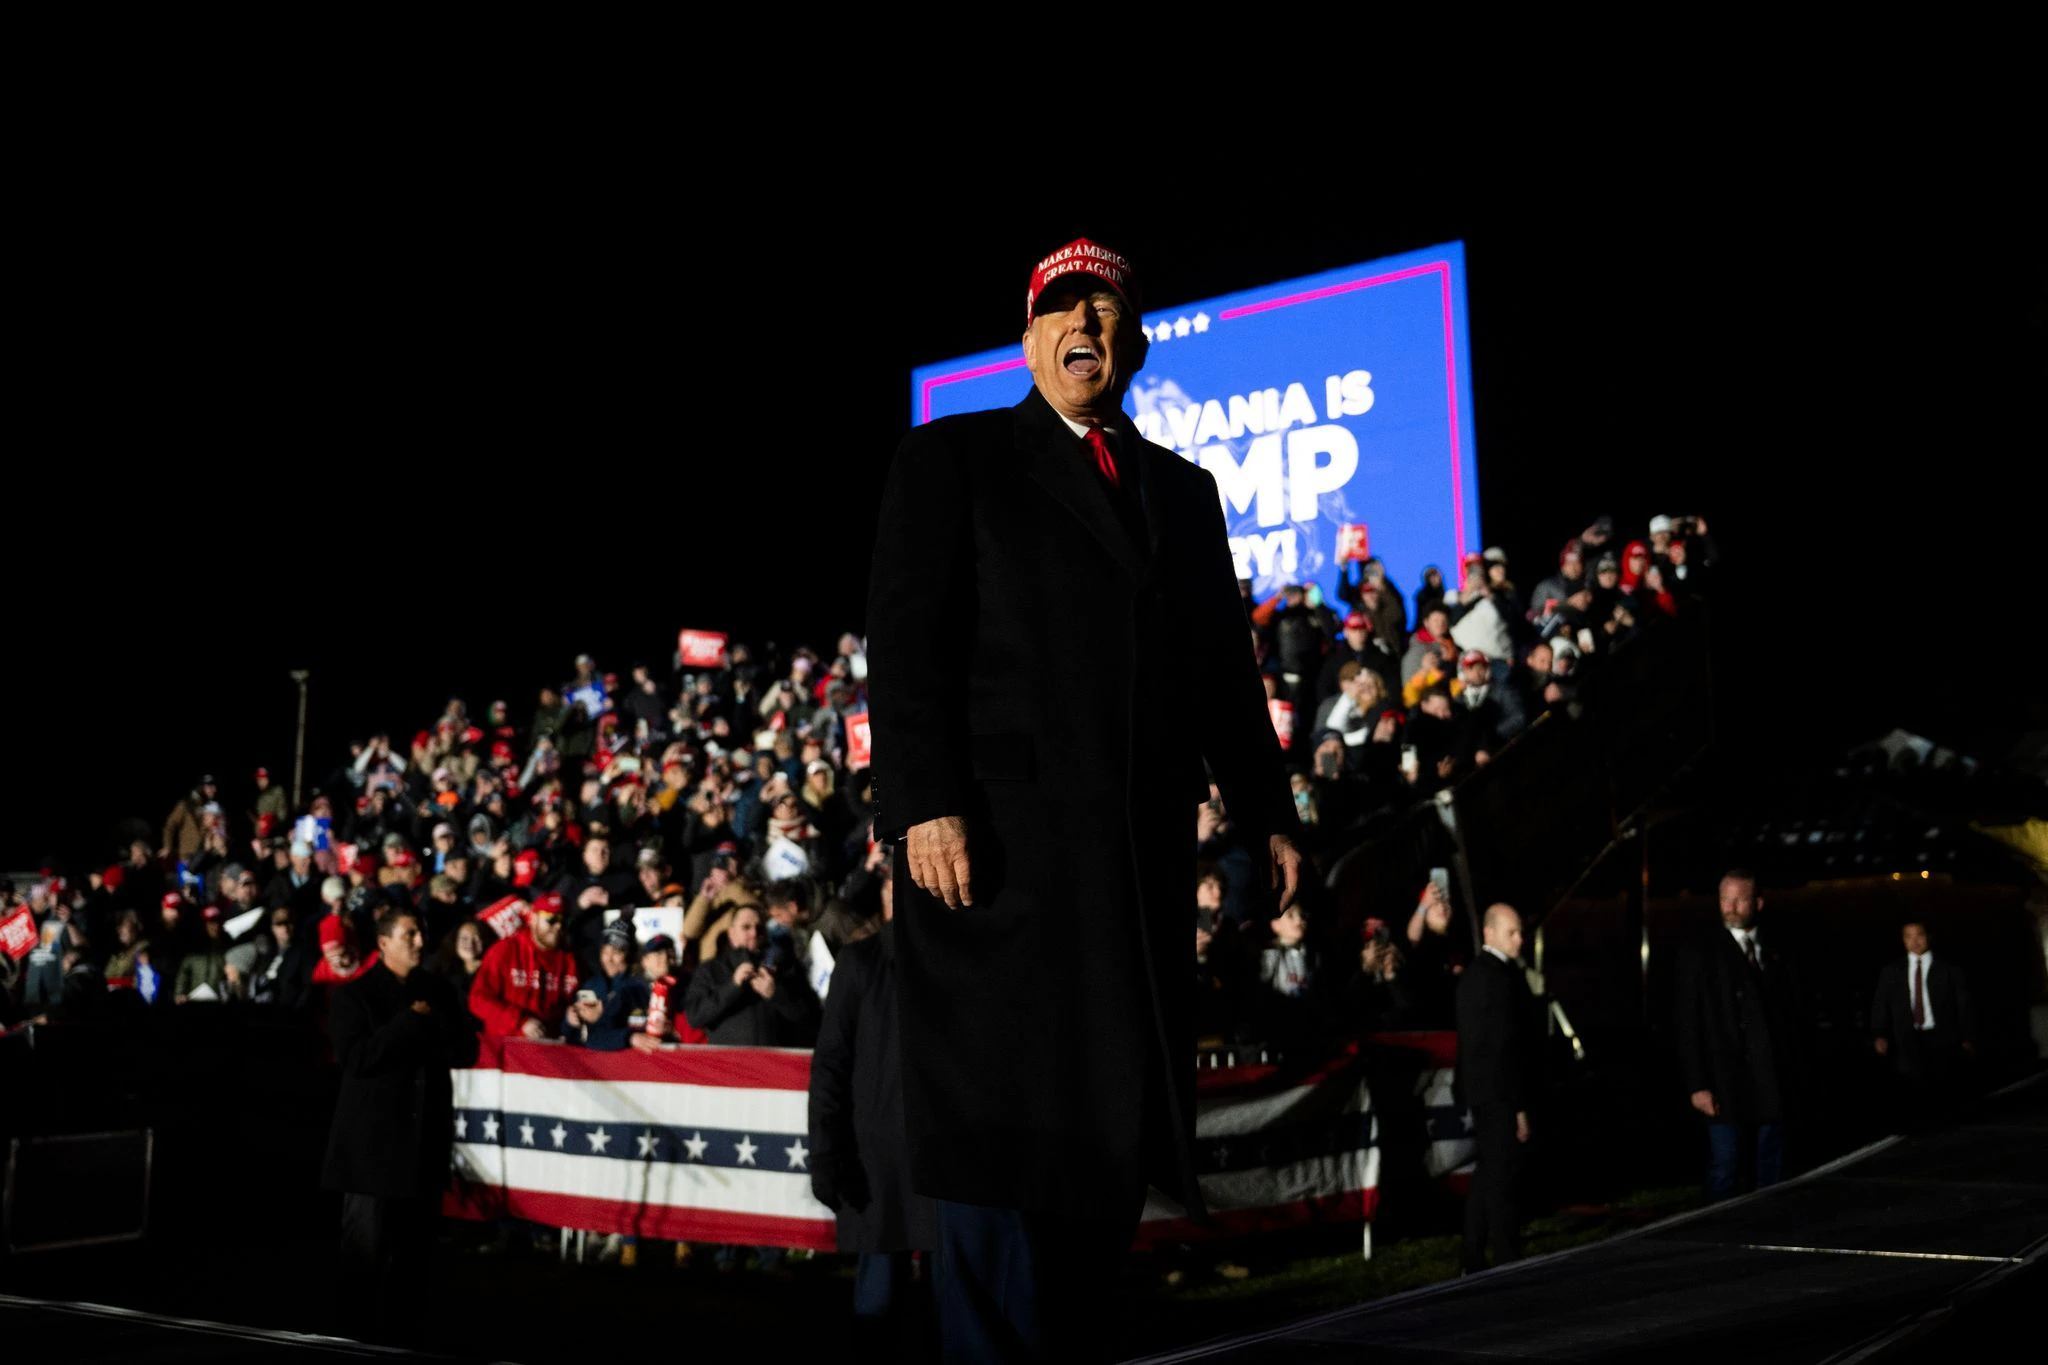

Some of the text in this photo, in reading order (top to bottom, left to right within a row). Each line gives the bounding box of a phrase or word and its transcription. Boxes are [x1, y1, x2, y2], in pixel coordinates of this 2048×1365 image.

[1038, 247, 1073, 273] MAKE
[1044, 260, 1123, 284] GREAT AGAIN
[1325, 369, 1375, 419] IS
[1180, 424, 1359, 528] MP
[1228, 528, 1298, 580] RY!
